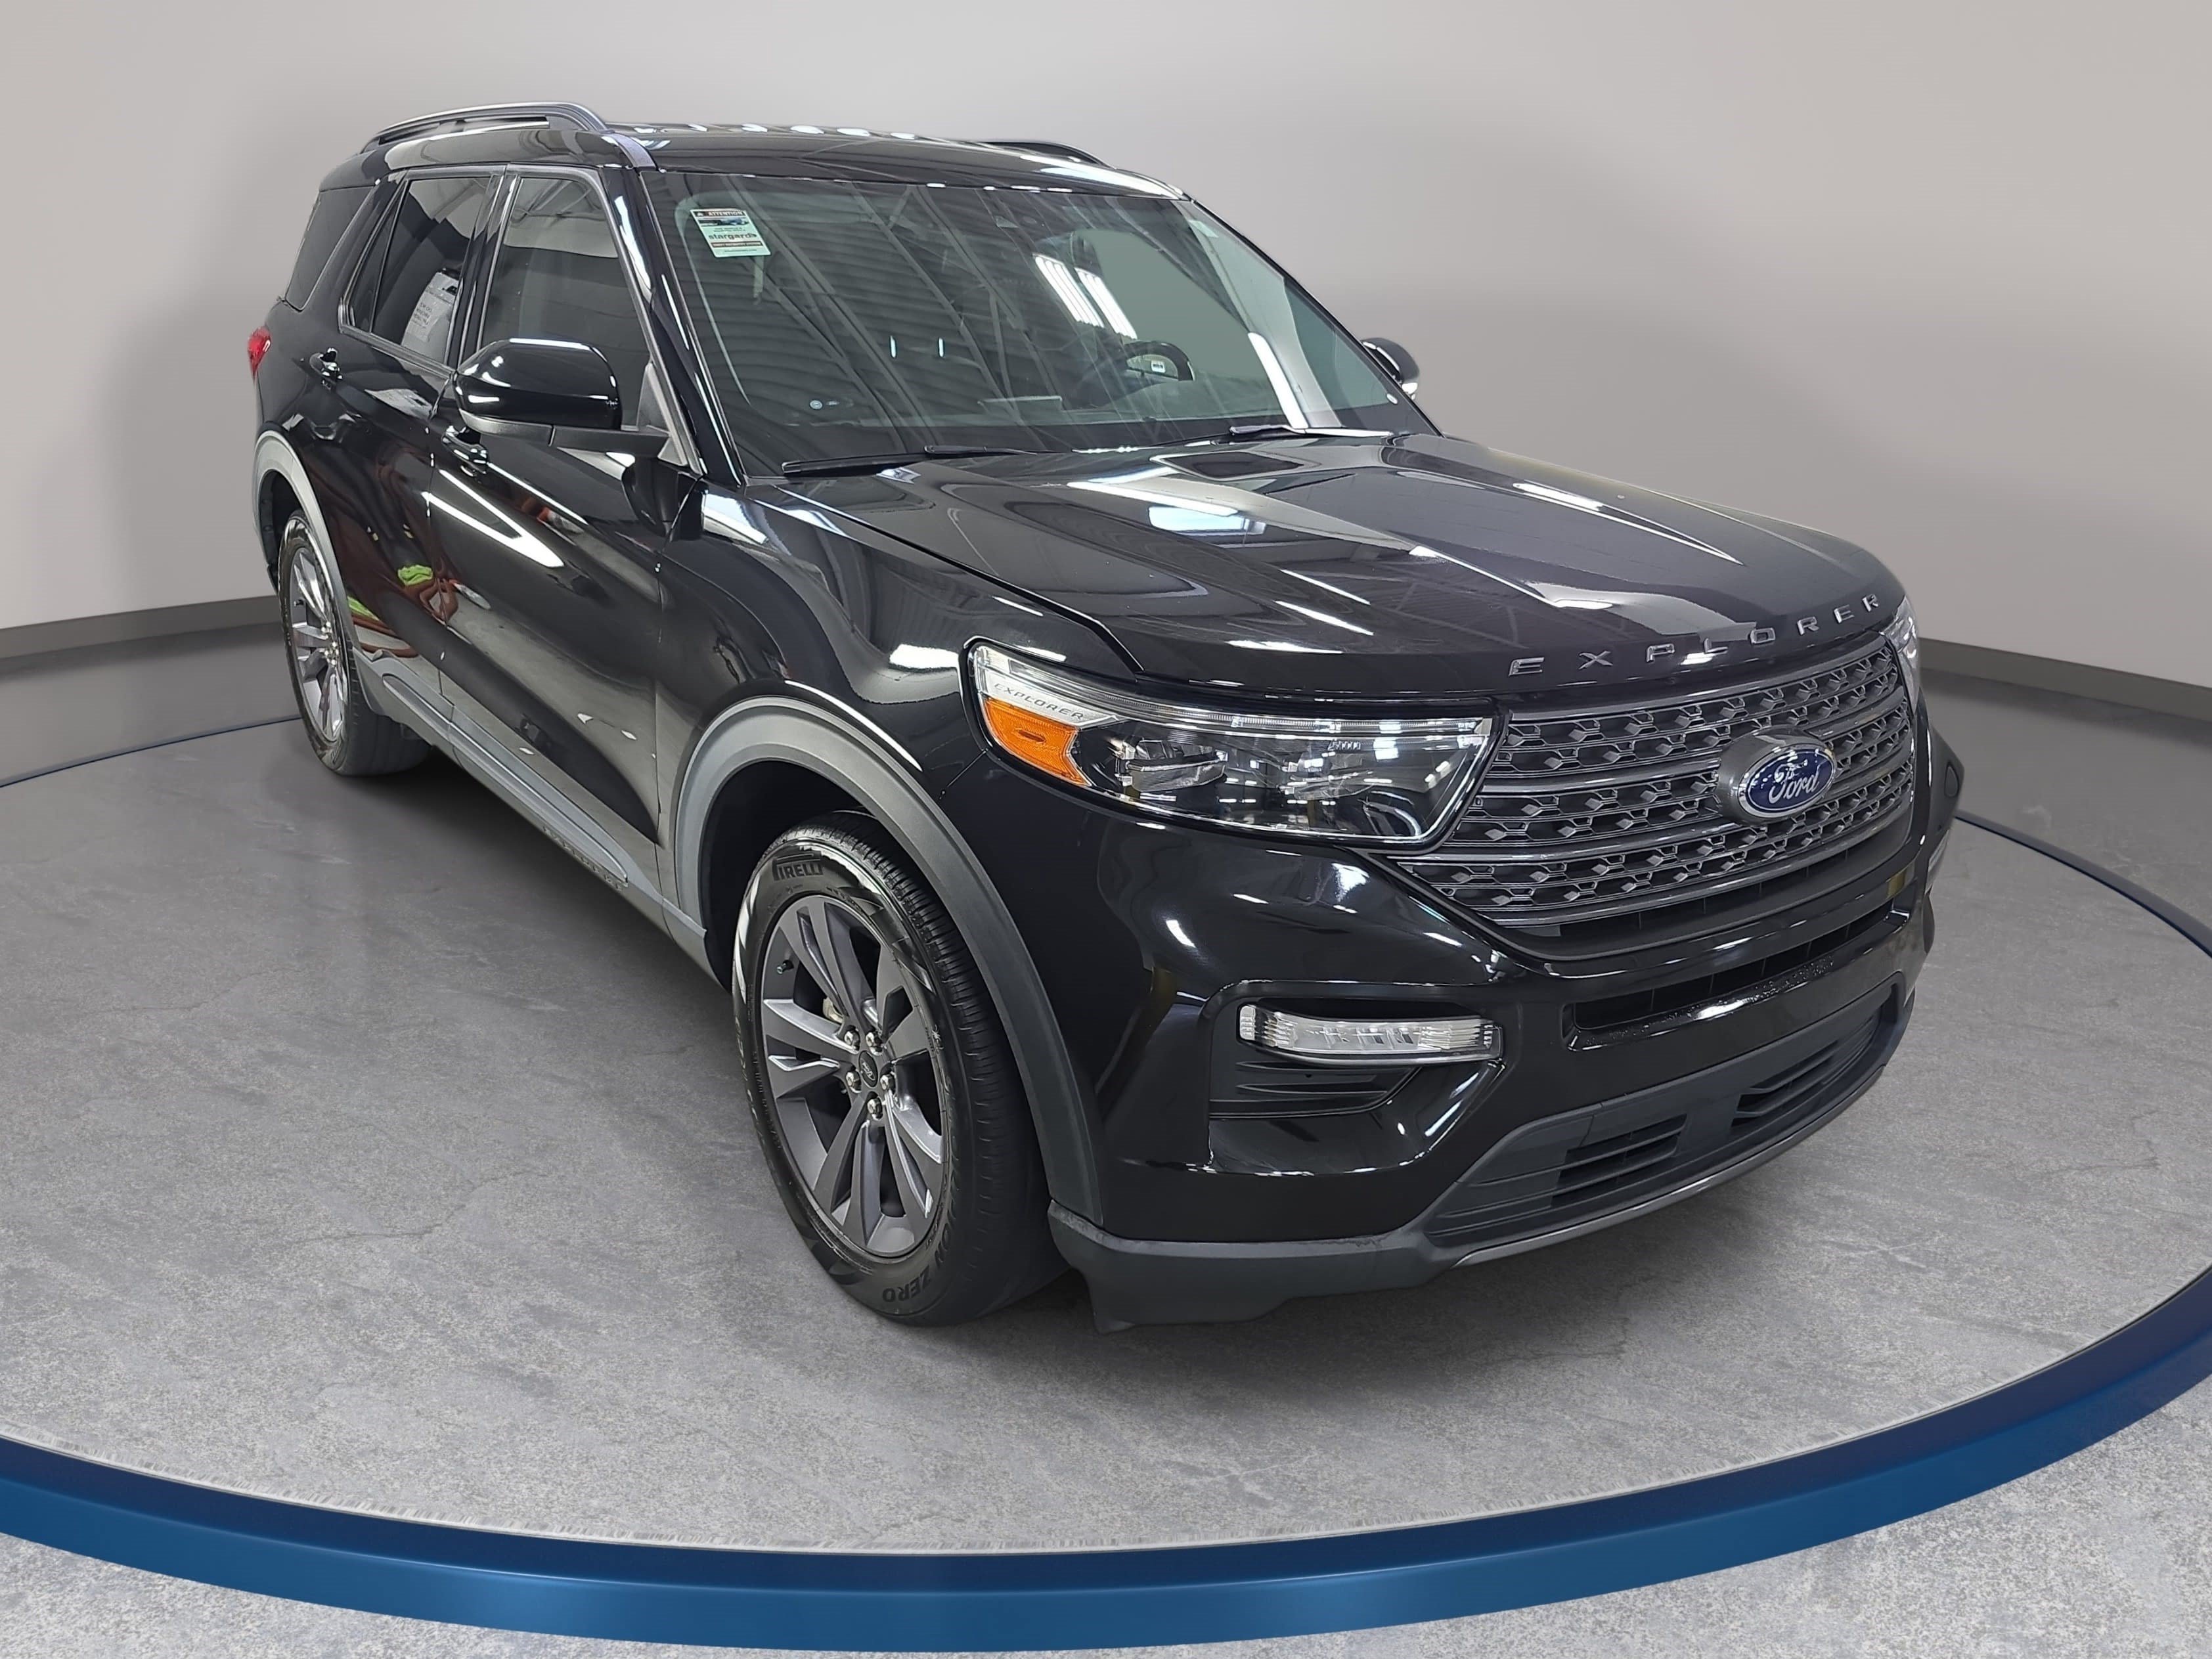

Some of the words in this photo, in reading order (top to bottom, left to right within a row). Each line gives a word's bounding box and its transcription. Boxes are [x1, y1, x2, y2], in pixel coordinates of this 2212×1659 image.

[1509, 593, 1880, 676] EXPLORER
[994, 683, 1084, 720] EXPLORER
[1769, 760, 1828, 804] Ford
[772, 851, 824, 881] PIRELLI
[882, 1264, 931, 1302] ZERO
